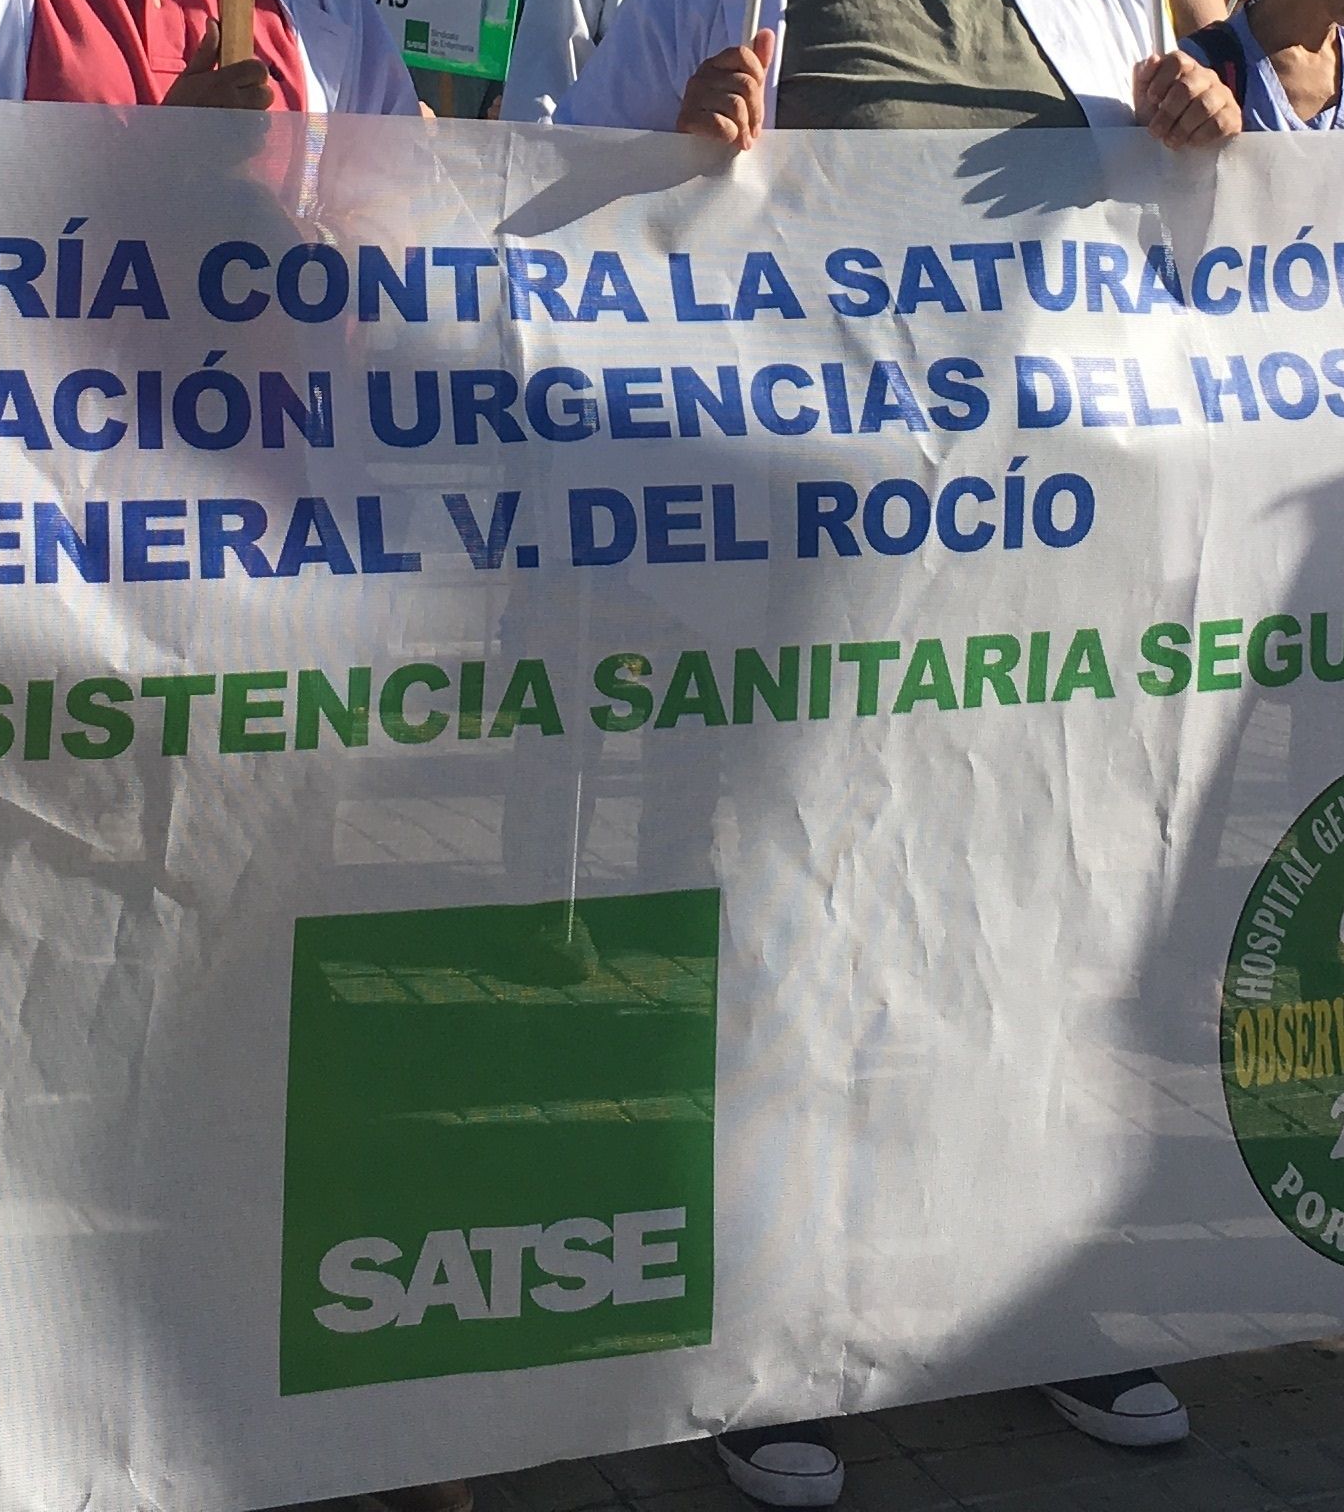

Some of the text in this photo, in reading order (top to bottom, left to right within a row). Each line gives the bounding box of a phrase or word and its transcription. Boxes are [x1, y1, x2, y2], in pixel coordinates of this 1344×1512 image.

[199, 240, 649, 326] CONTRA
[668, 248, 805, 323] LA
[367, 358, 990, 447] URGENCIAS
[1017, 357, 1181, 432] DEL
[445, 491, 540, 570] V.
[569, 483, 769, 564] DEL
[796, 456, 1096, 557] ROCÍO
[589, 624, 1115, 734] SANITARIA
[1236, 848, 1322, 1000] HOSPITAL
[313, 1207, 686, 1333] SATSE
